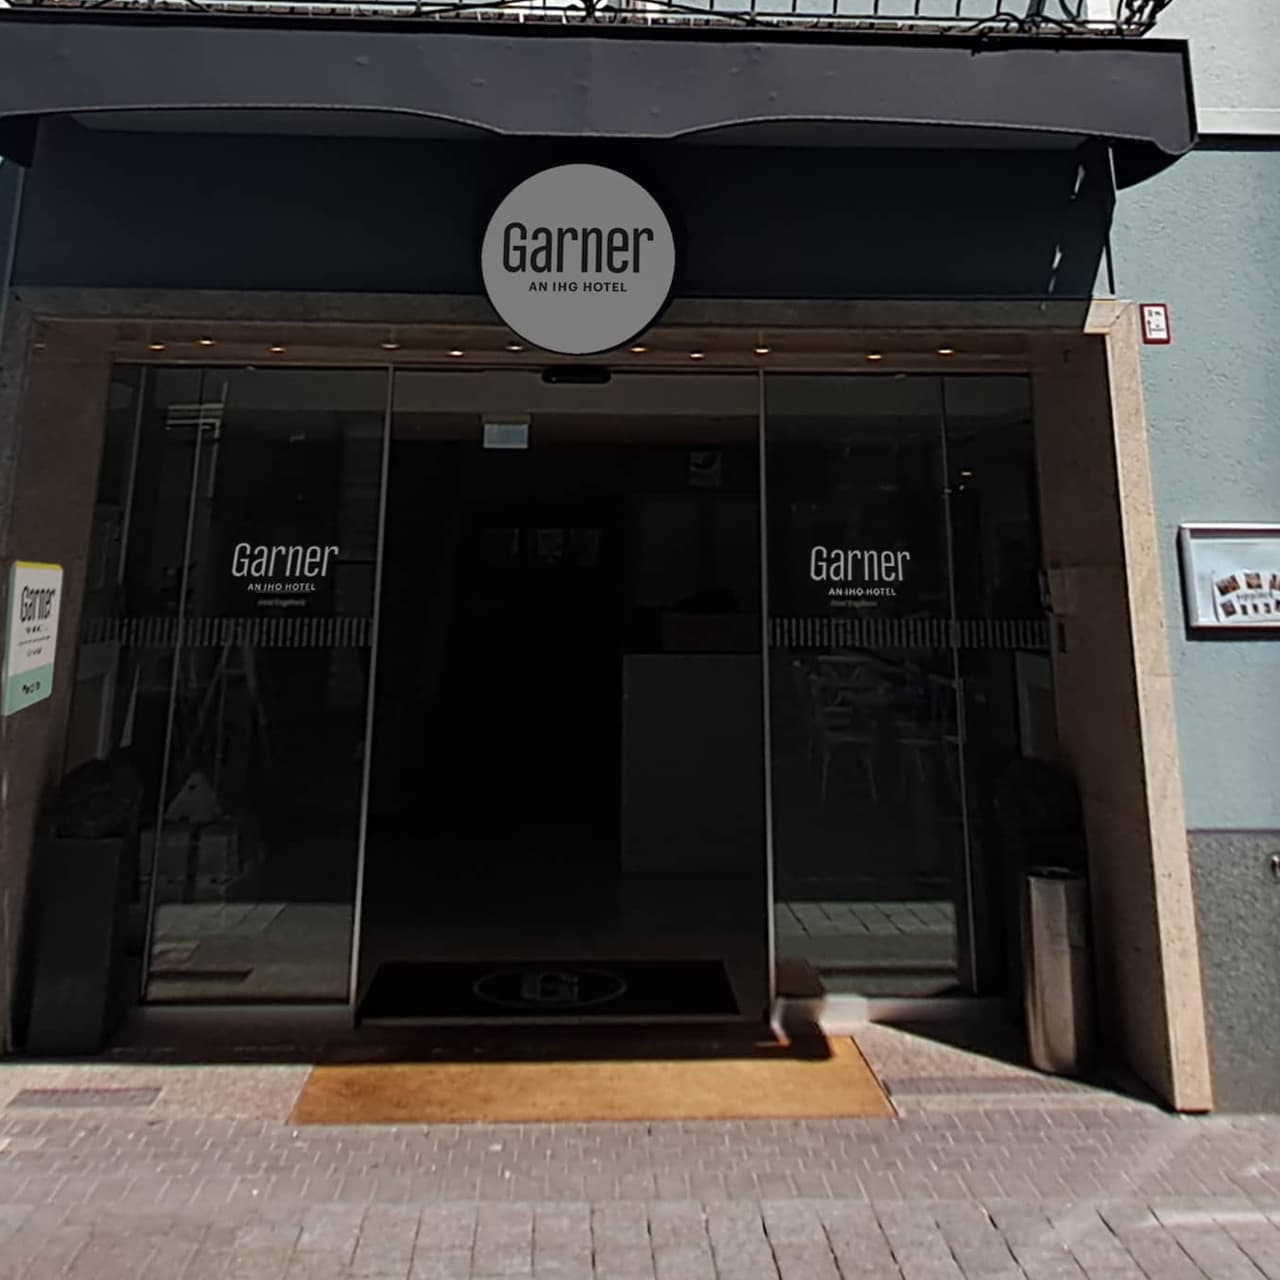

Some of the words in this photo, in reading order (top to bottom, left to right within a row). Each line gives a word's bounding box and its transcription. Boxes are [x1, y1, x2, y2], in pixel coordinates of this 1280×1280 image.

[502, 222, 654, 273] Garner
[529, 281, 548, 292] AN
[552, 281, 578, 292] IHG
[583, 281, 627, 292] HOTEL
[231, 542, 339, 577] Garner
[810, 546, 910, 581] Garner
[247, 583, 261, 591] AN
[285, 583, 316, 591] HOTEL
[828, 587, 843, 596] AN
[866, 587, 896, 596] HOTEL
